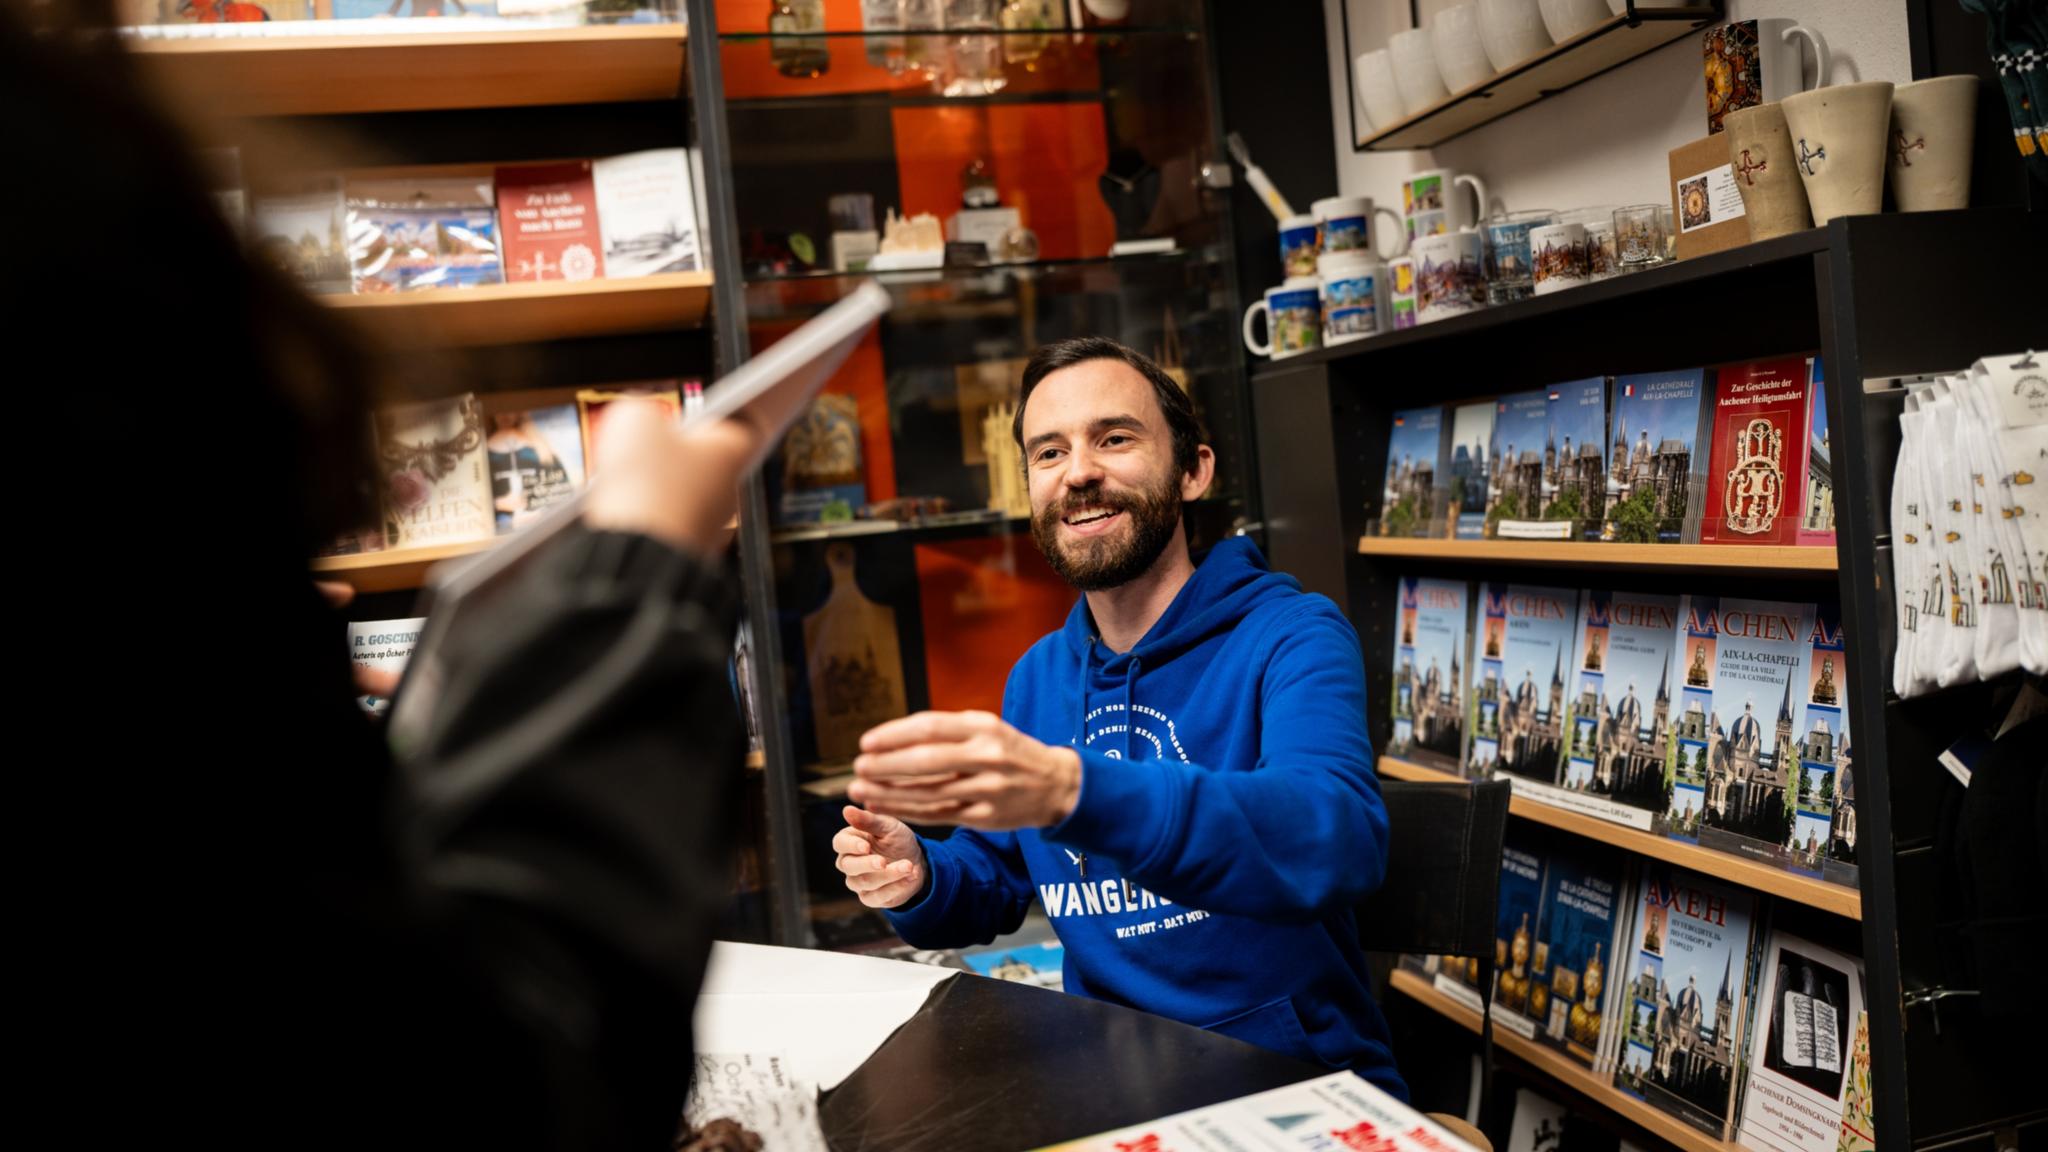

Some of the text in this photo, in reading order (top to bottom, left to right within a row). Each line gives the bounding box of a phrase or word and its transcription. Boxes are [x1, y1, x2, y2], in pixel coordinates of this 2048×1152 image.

[1731, 379, 1793, 393] Zur Geschichte der
[1719, 391, 1802, 407] Aachener Heiligtumsfahrt
[1485, 592, 1564, 620] AACHEN
[1585, 600, 1675, 630] AACHEN
[1683, 608, 1800, 641] AACHEN
[355, 636, 366, 646] R.
[377, 651, 385, 660] op
[1720, 663, 1740, 671] GUIDE
[1760, 667, 1776, 675] VILLE
[1729, 672, 1738, 680] DE
[1739, 673, 1747, 681] LA
[1116, 925, 1135, 939] WAT
[1137, 921, 1156, 935] MUT
[1163, 915, 1184, 929] DAT
